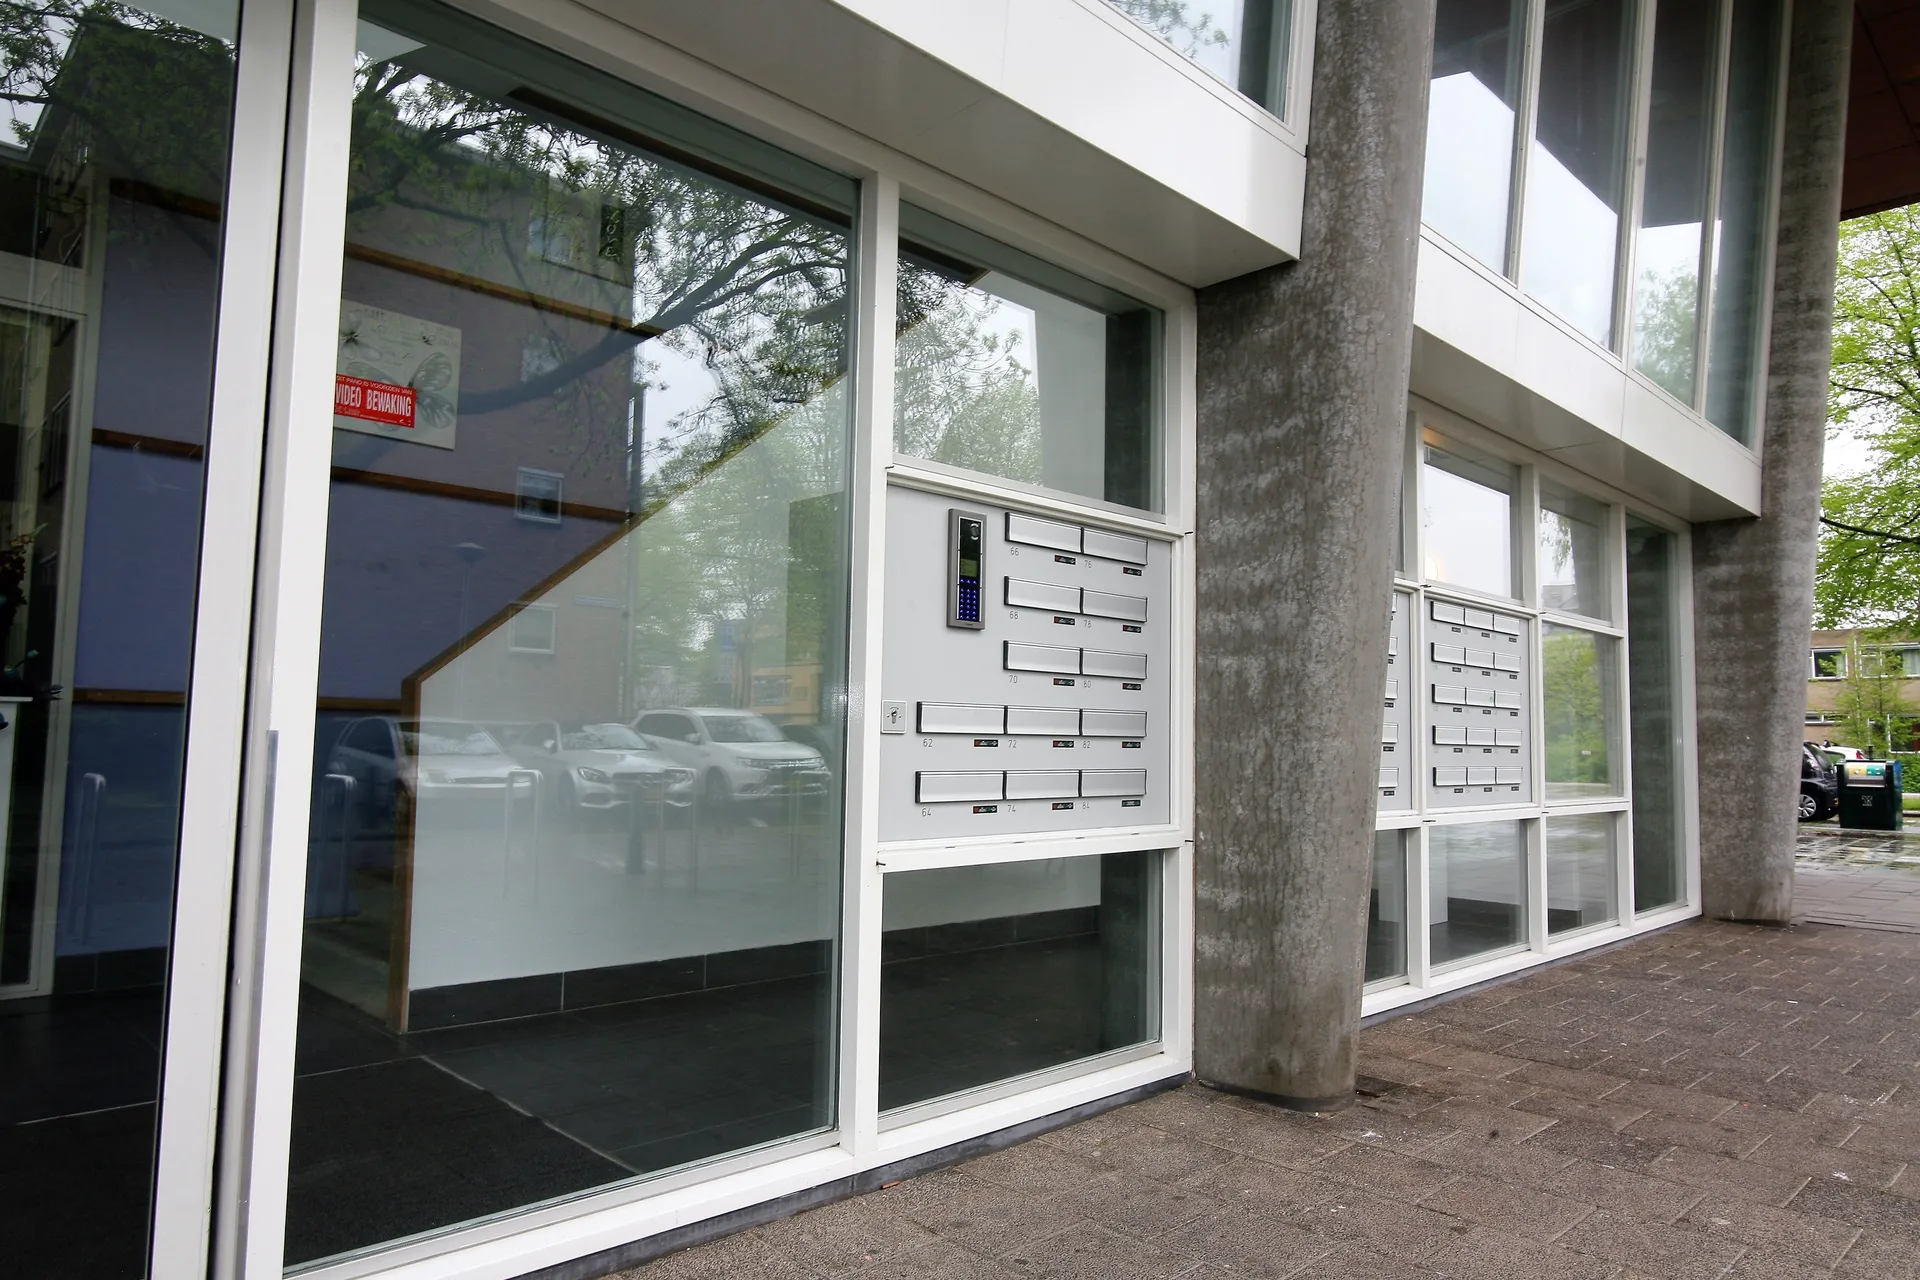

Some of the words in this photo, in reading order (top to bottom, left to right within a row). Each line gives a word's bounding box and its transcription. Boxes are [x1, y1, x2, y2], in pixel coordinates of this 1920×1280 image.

[336, 383, 361, 407] VIDEO
[366, 390, 412, 416] BEWAKING
[1010, 547, 1019, 556] 66
[1009, 611, 1018, 620] 68
[1009, 675, 1018, 684] 70
[923, 738, 933, 748] 62
[1008, 740, 1017, 748] 72
[922, 808, 932, 817] 64
